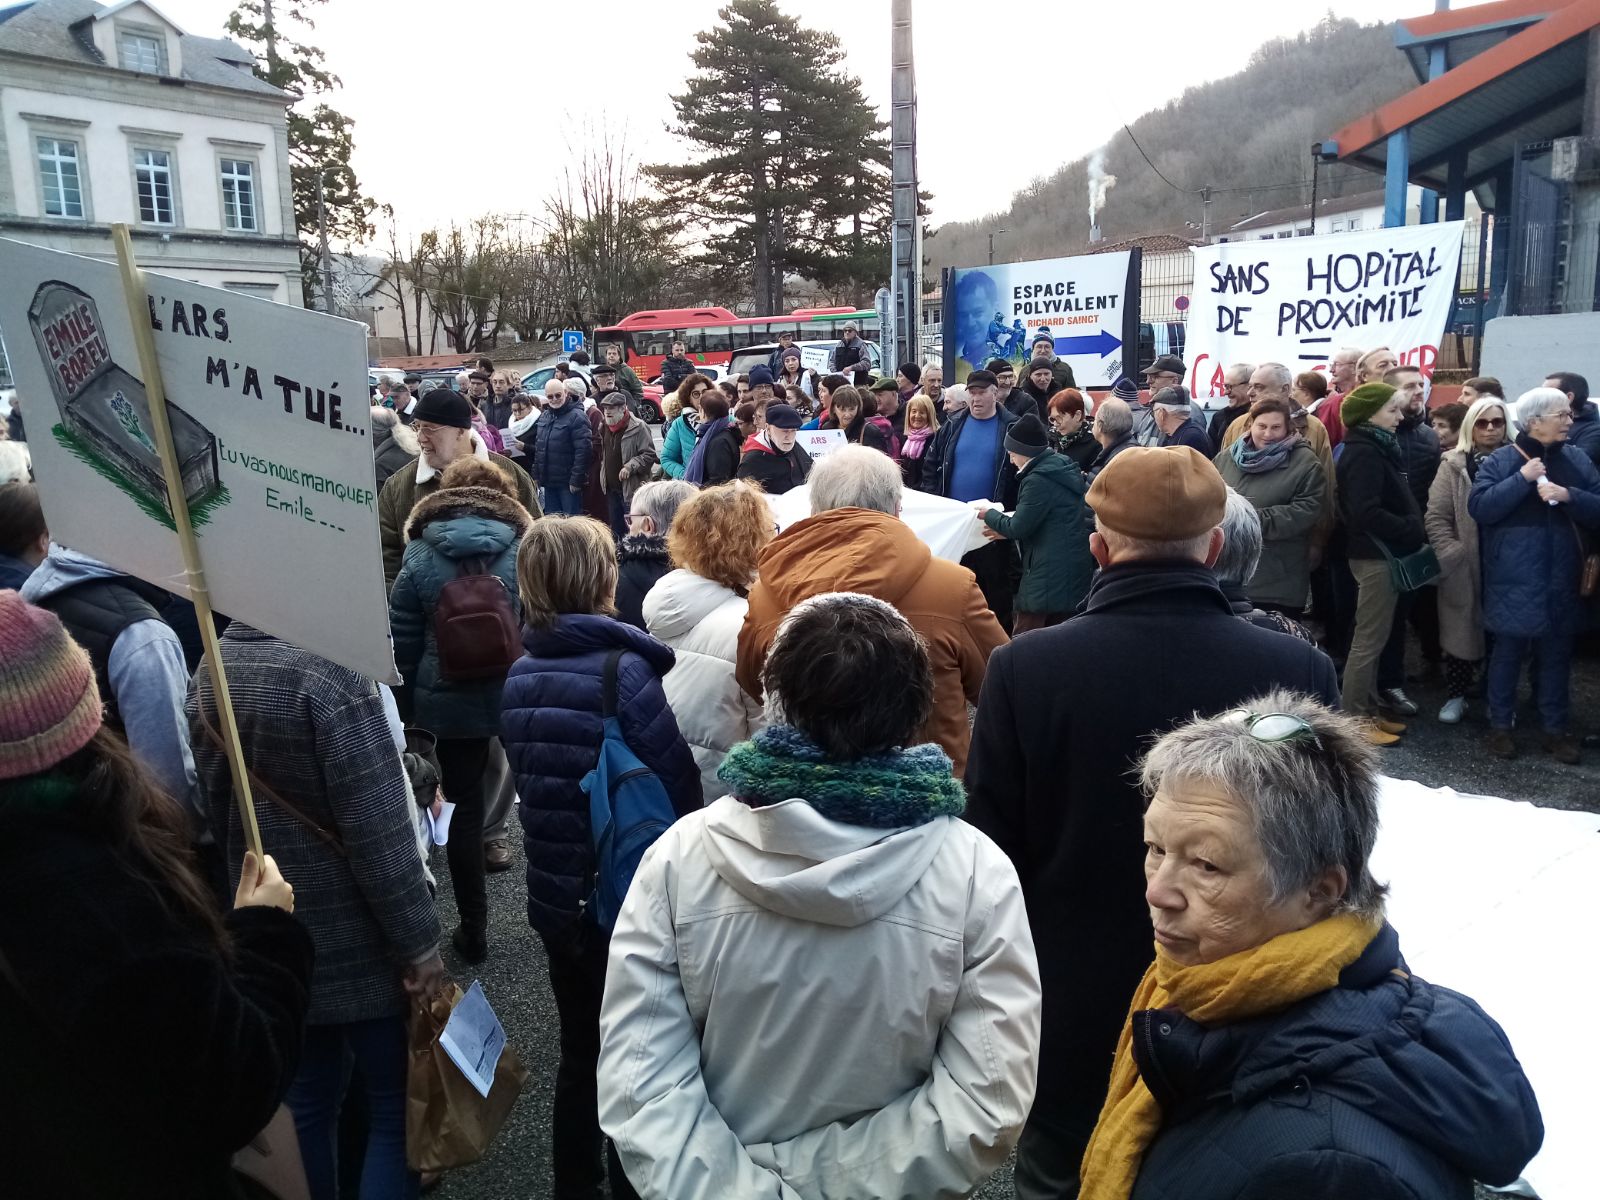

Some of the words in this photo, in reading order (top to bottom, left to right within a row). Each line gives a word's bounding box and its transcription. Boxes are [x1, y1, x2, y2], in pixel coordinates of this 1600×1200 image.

[1210, 261, 1270, 295] SANS
[1013, 281, 1076, 300] ESPACE
[1457, 296, 1476, 305] ACK
[1013, 294, 1119, 316] POLYVALENT
[1027, 316, 1065, 328] RICHARD
[1216, 305, 1252, 336] DE
[568, 335, 578, 349] P
[59, 336, 108, 394] BOREL
[206, 355, 263, 400] M'A
[810, 436, 828, 445] ARS
